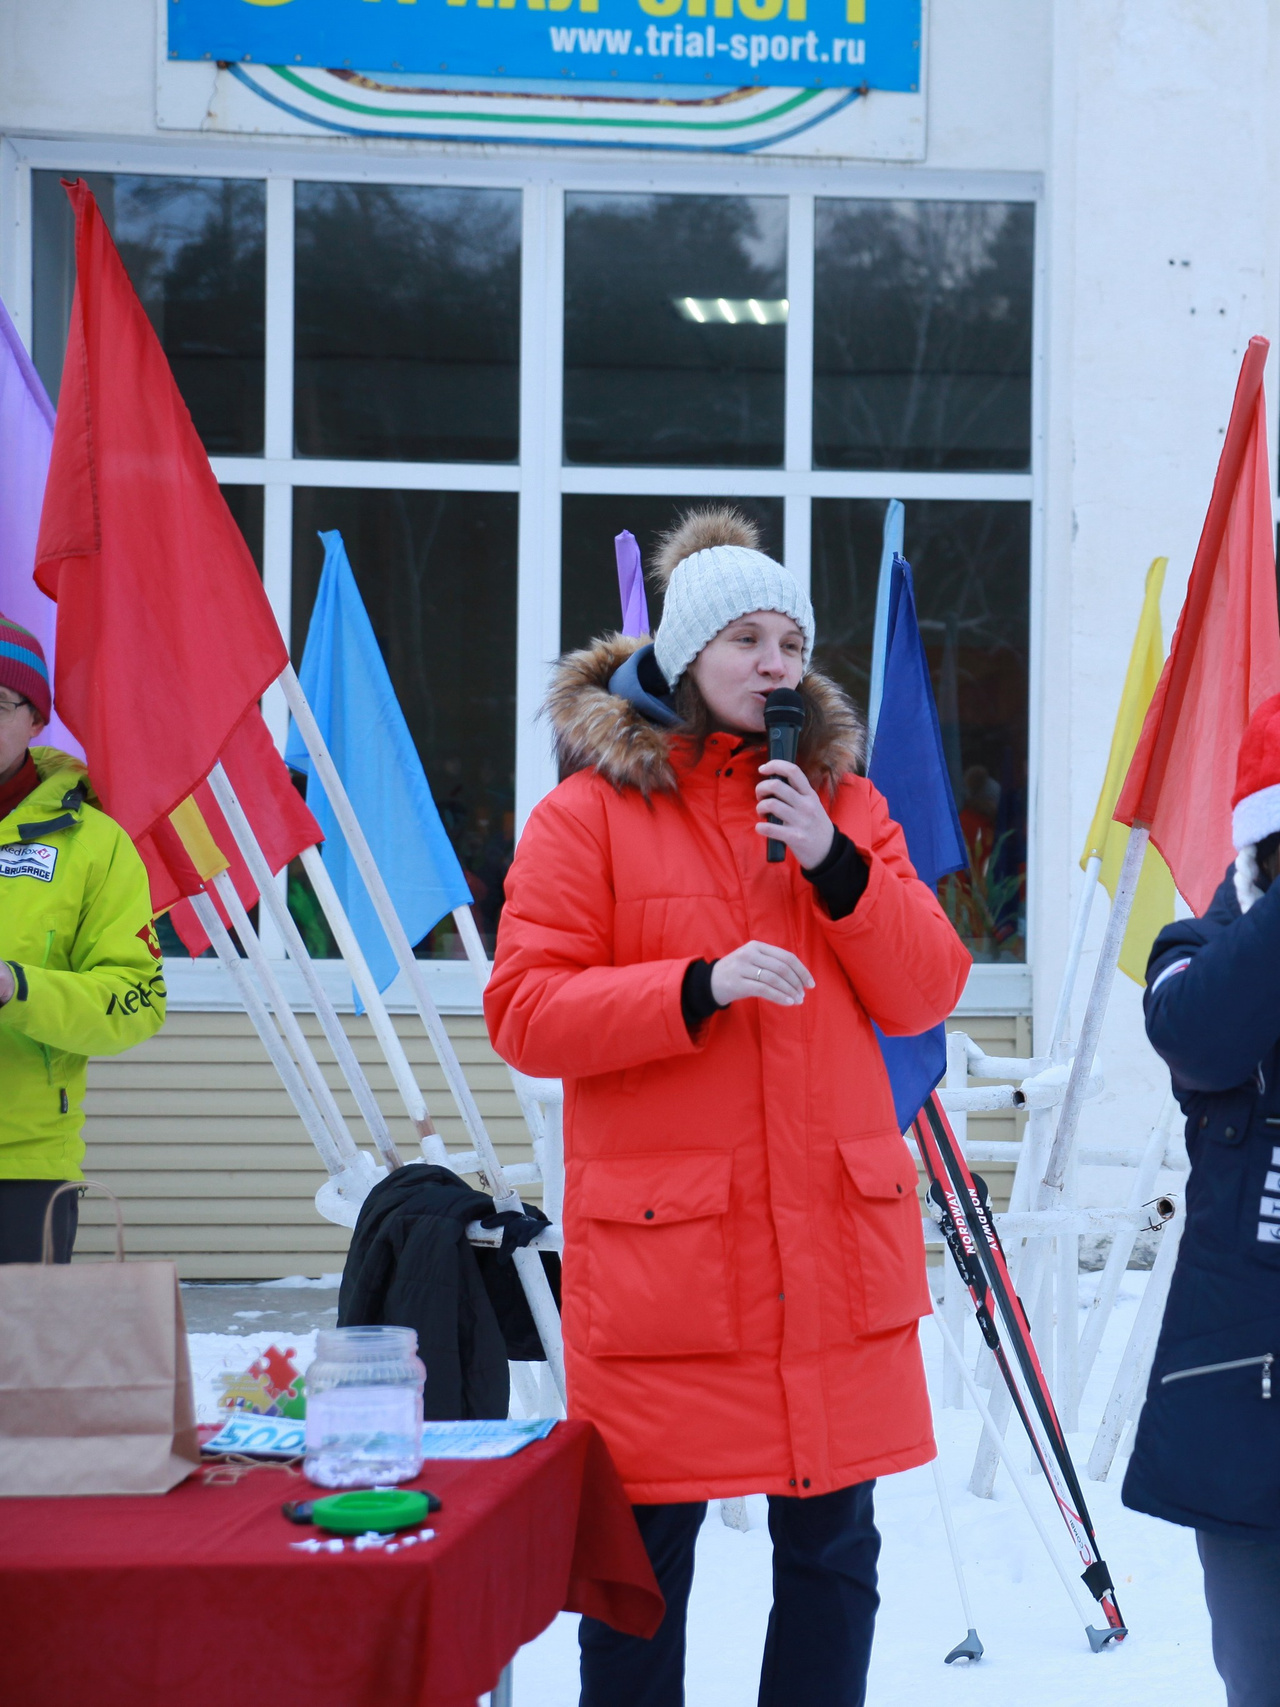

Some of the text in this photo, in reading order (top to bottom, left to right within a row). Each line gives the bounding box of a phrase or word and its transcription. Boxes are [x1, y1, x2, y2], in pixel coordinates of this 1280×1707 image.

[550, 24, 865, 67] www.trial-sport.ru
[945, 1190, 977, 1255] NORDWAY
[967, 1187, 999, 1252] NORDWAY
[209, 1422, 308, 1452] 500
